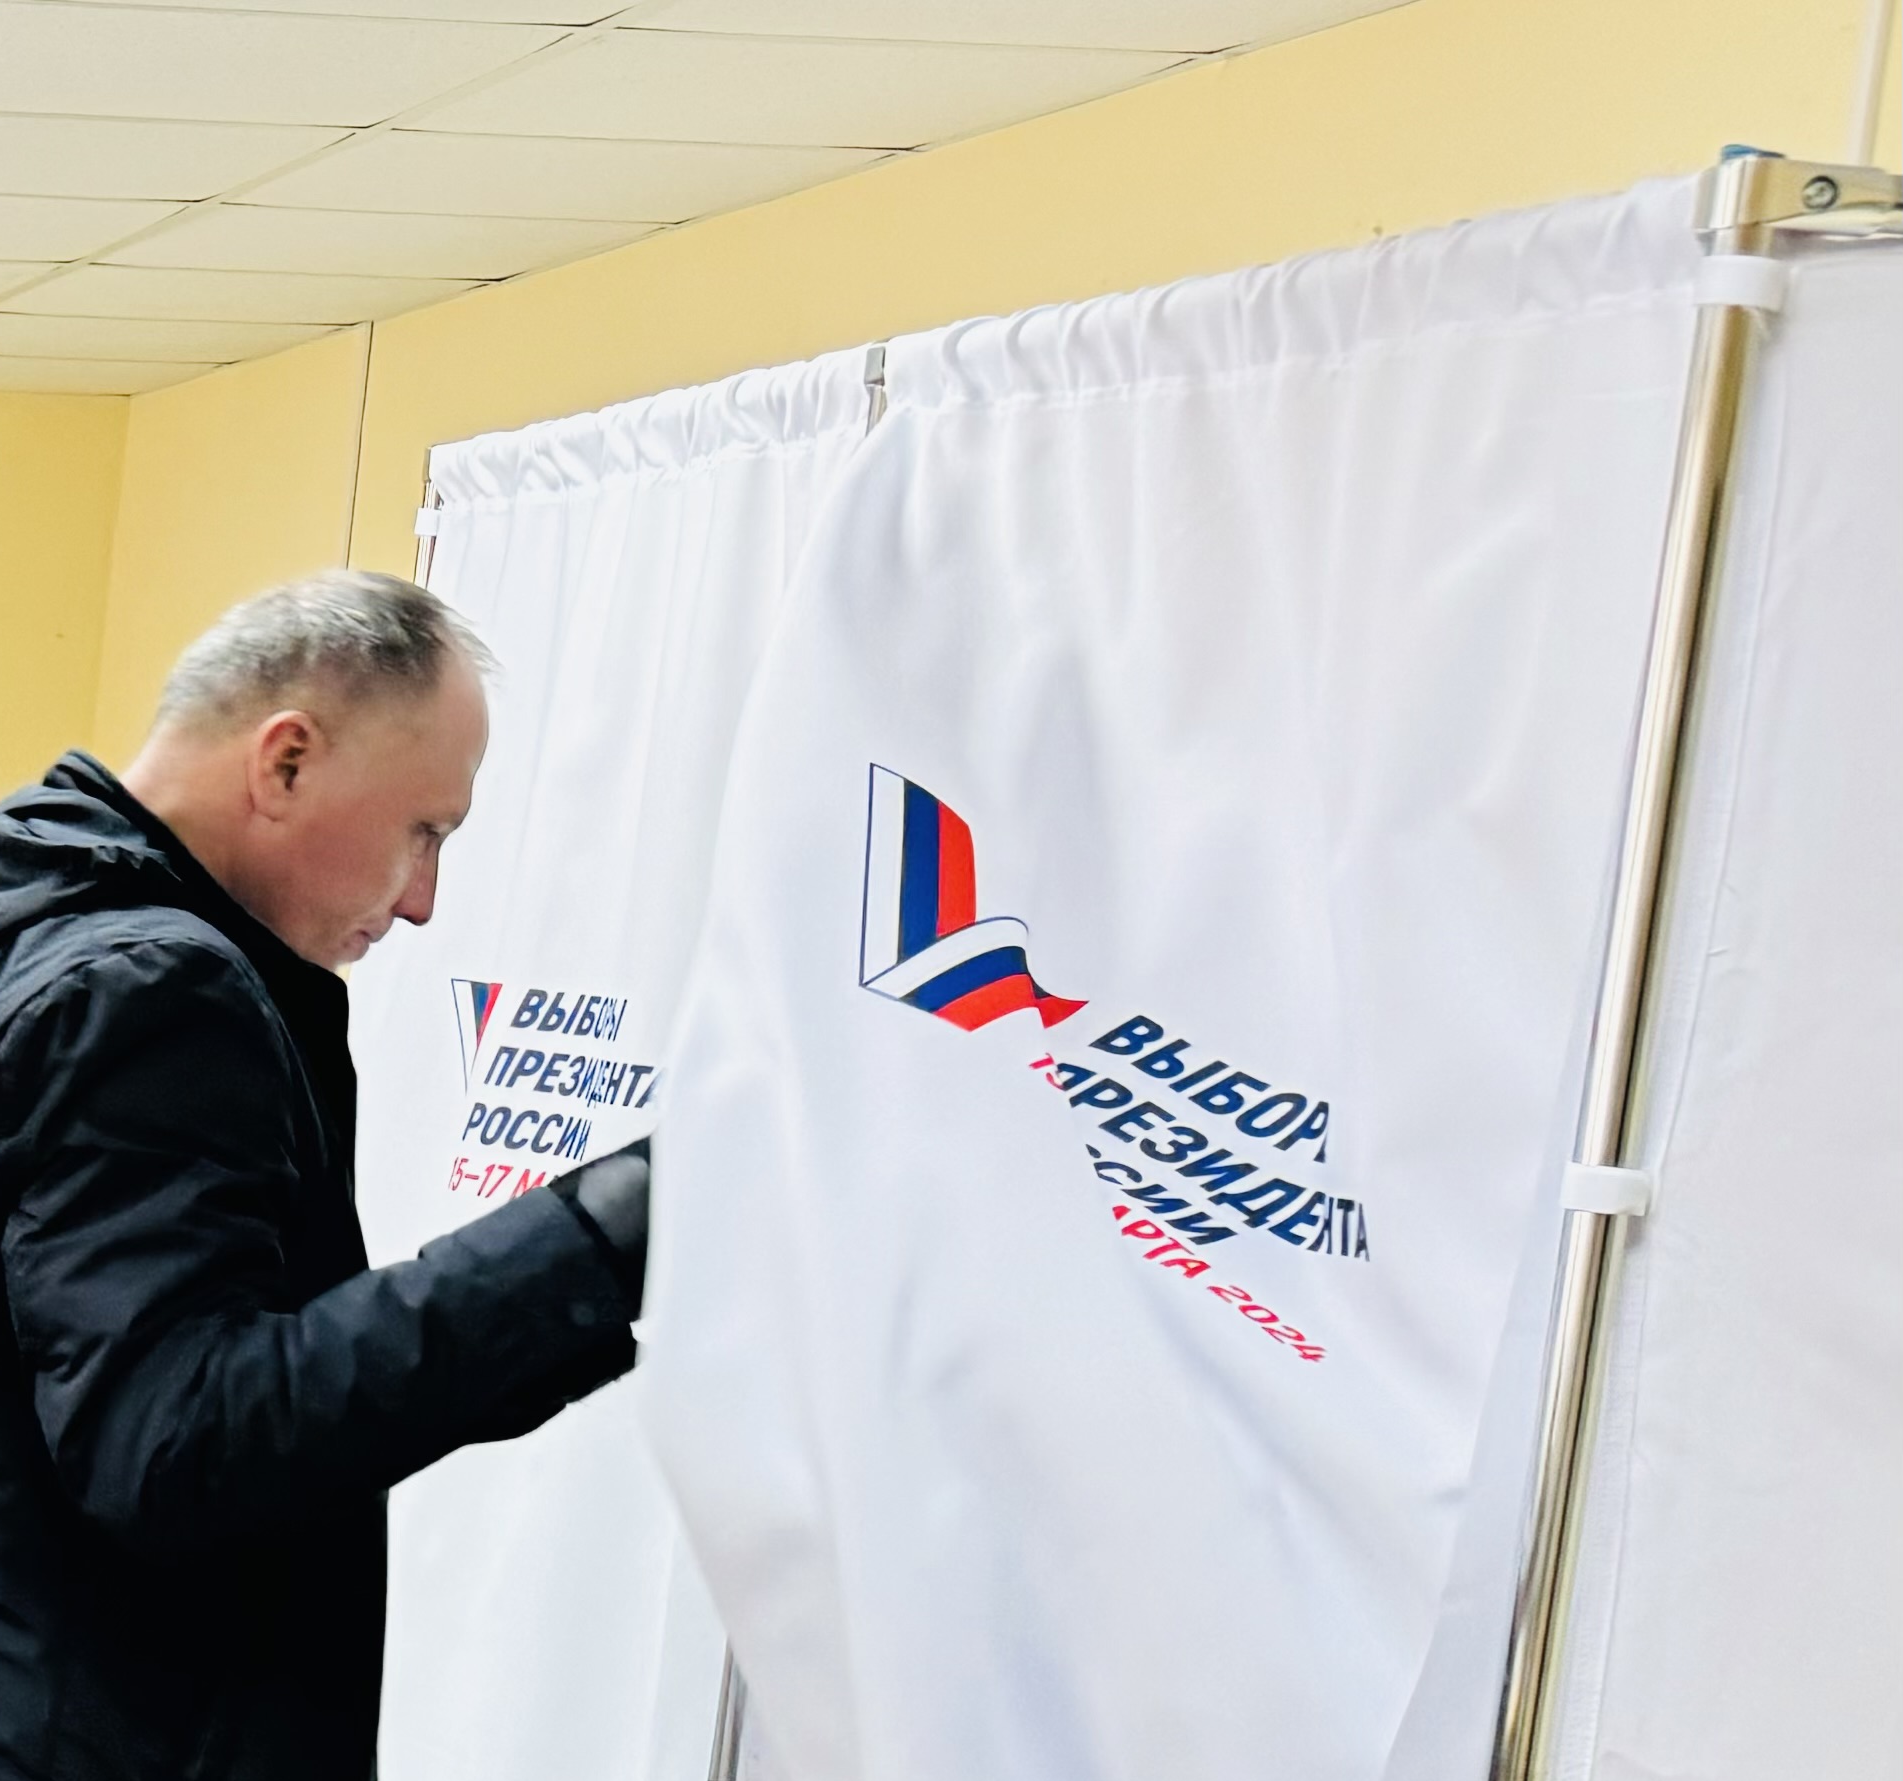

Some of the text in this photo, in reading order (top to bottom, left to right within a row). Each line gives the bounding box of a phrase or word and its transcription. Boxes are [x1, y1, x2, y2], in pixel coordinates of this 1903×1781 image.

[1088, 1014, 1330, 1164] ВЫБОР
[461, 1102, 593, 1162] РОССИИ
[1205, 1283, 1328, 1364] 2024
